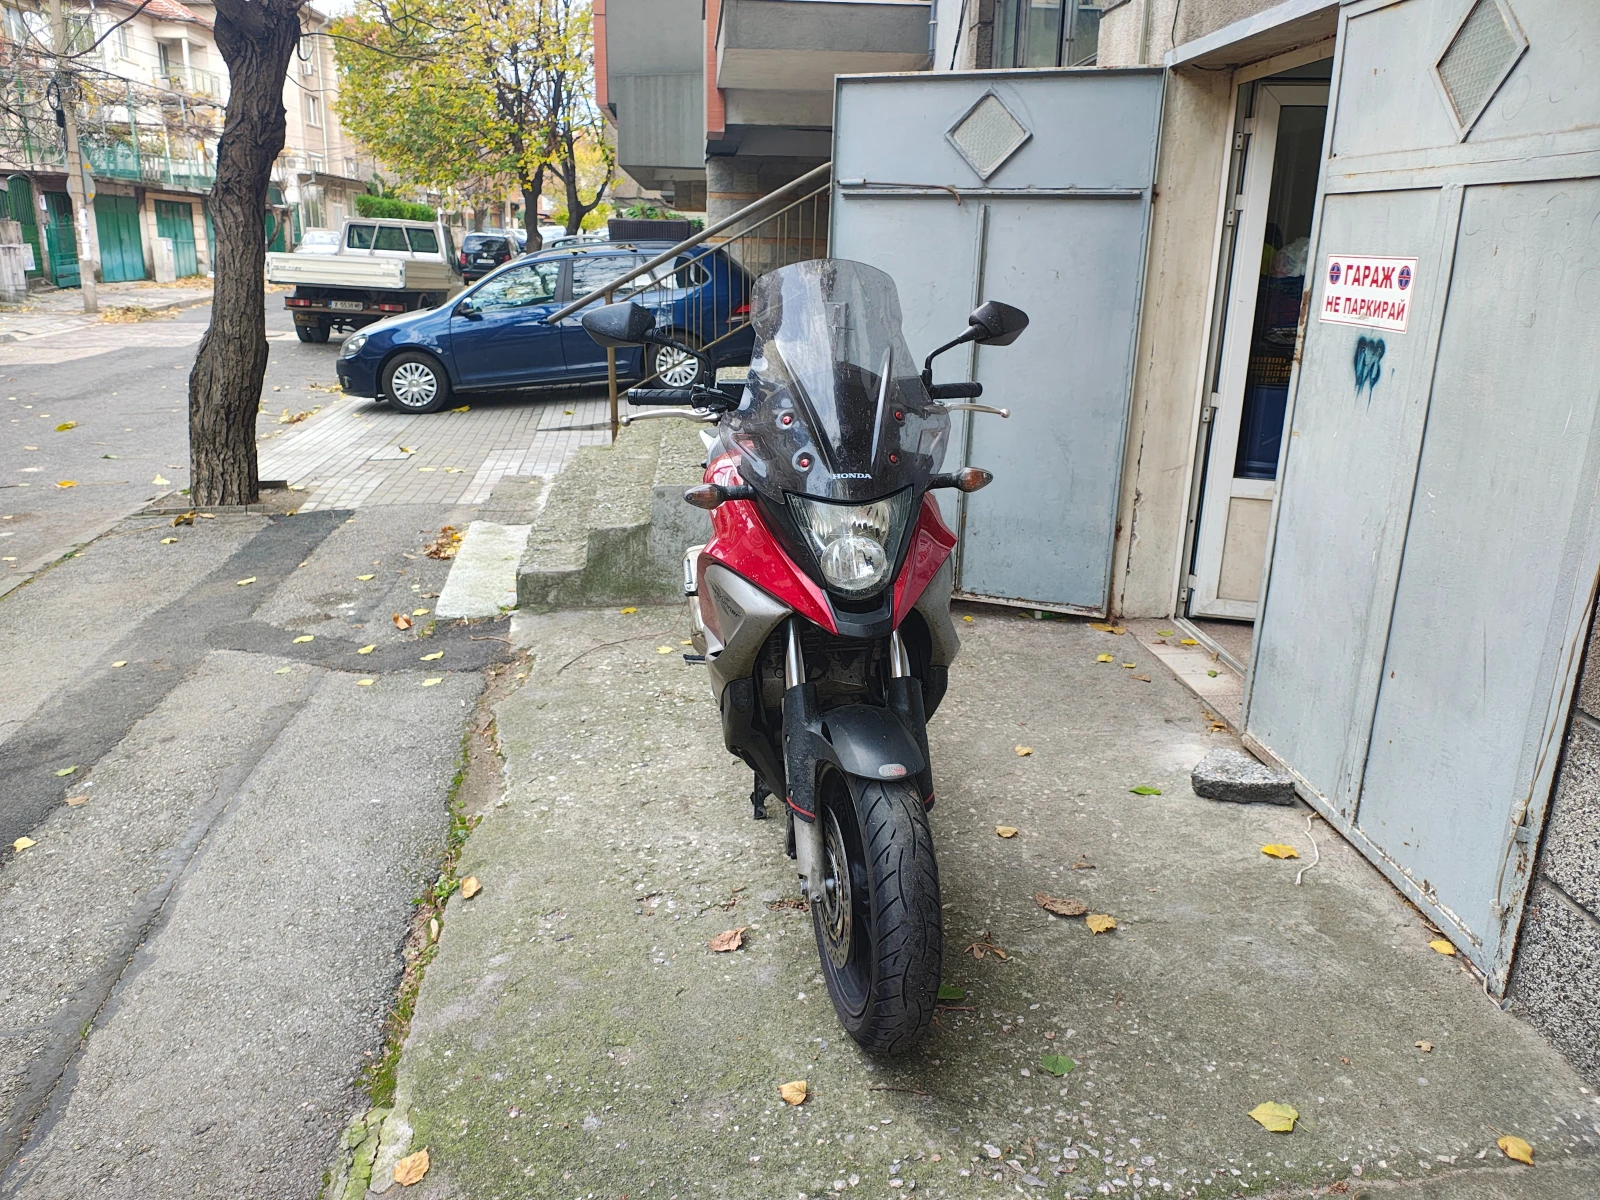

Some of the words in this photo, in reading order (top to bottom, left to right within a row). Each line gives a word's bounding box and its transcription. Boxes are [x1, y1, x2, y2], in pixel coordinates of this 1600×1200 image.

[1343, 264, 1396, 289] ГАРАЖ
[1325, 295, 1341, 313] НЕ
[1343, 297, 1406, 321] ПАРКИРАЙ
